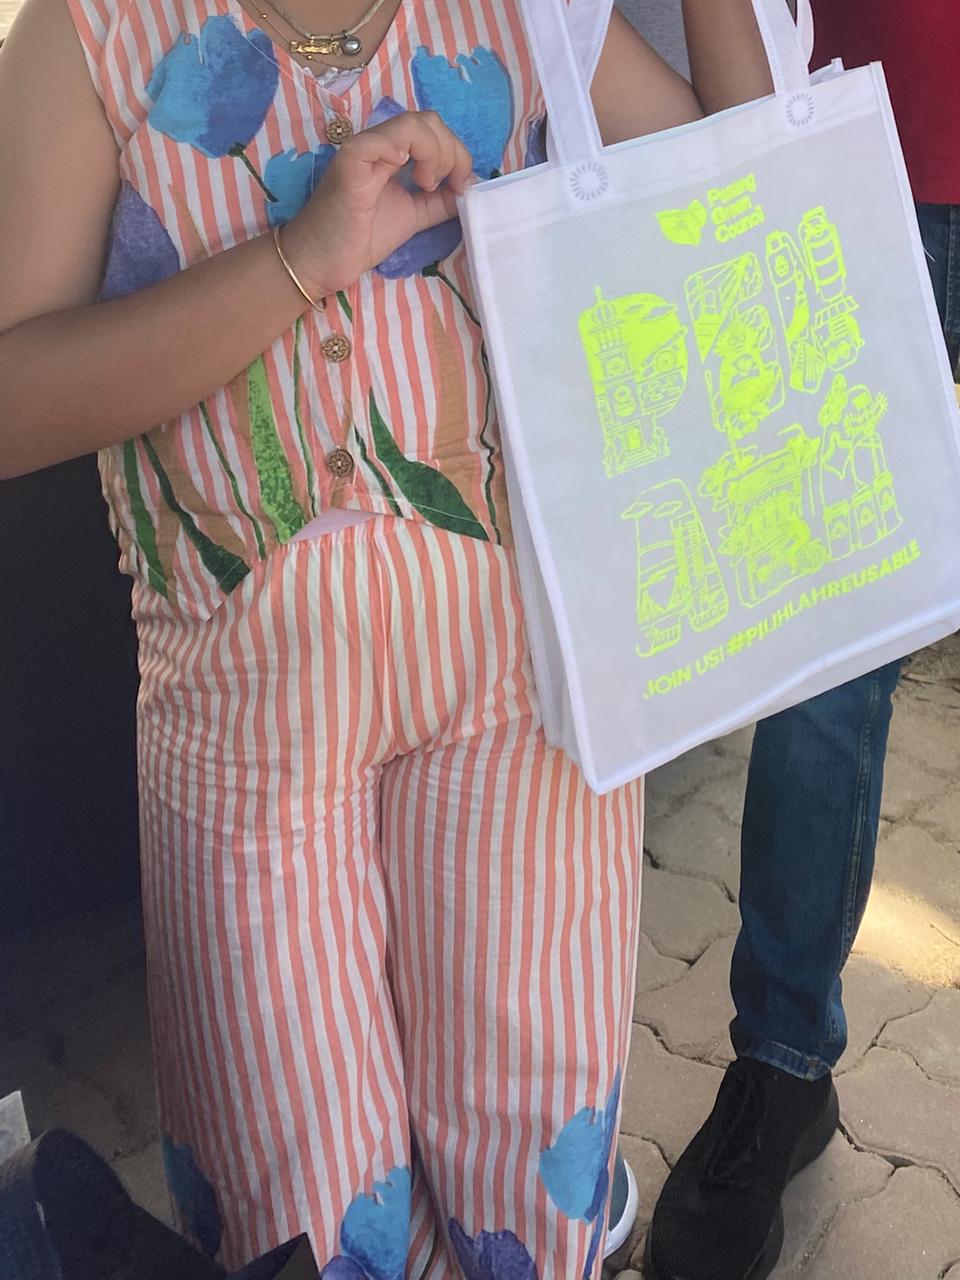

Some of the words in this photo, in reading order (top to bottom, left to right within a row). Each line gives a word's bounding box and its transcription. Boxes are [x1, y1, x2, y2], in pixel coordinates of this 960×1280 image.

[715, 204, 765, 243] Council
[643, 665, 692, 699] JOIN
[695, 648, 724, 676] US!
